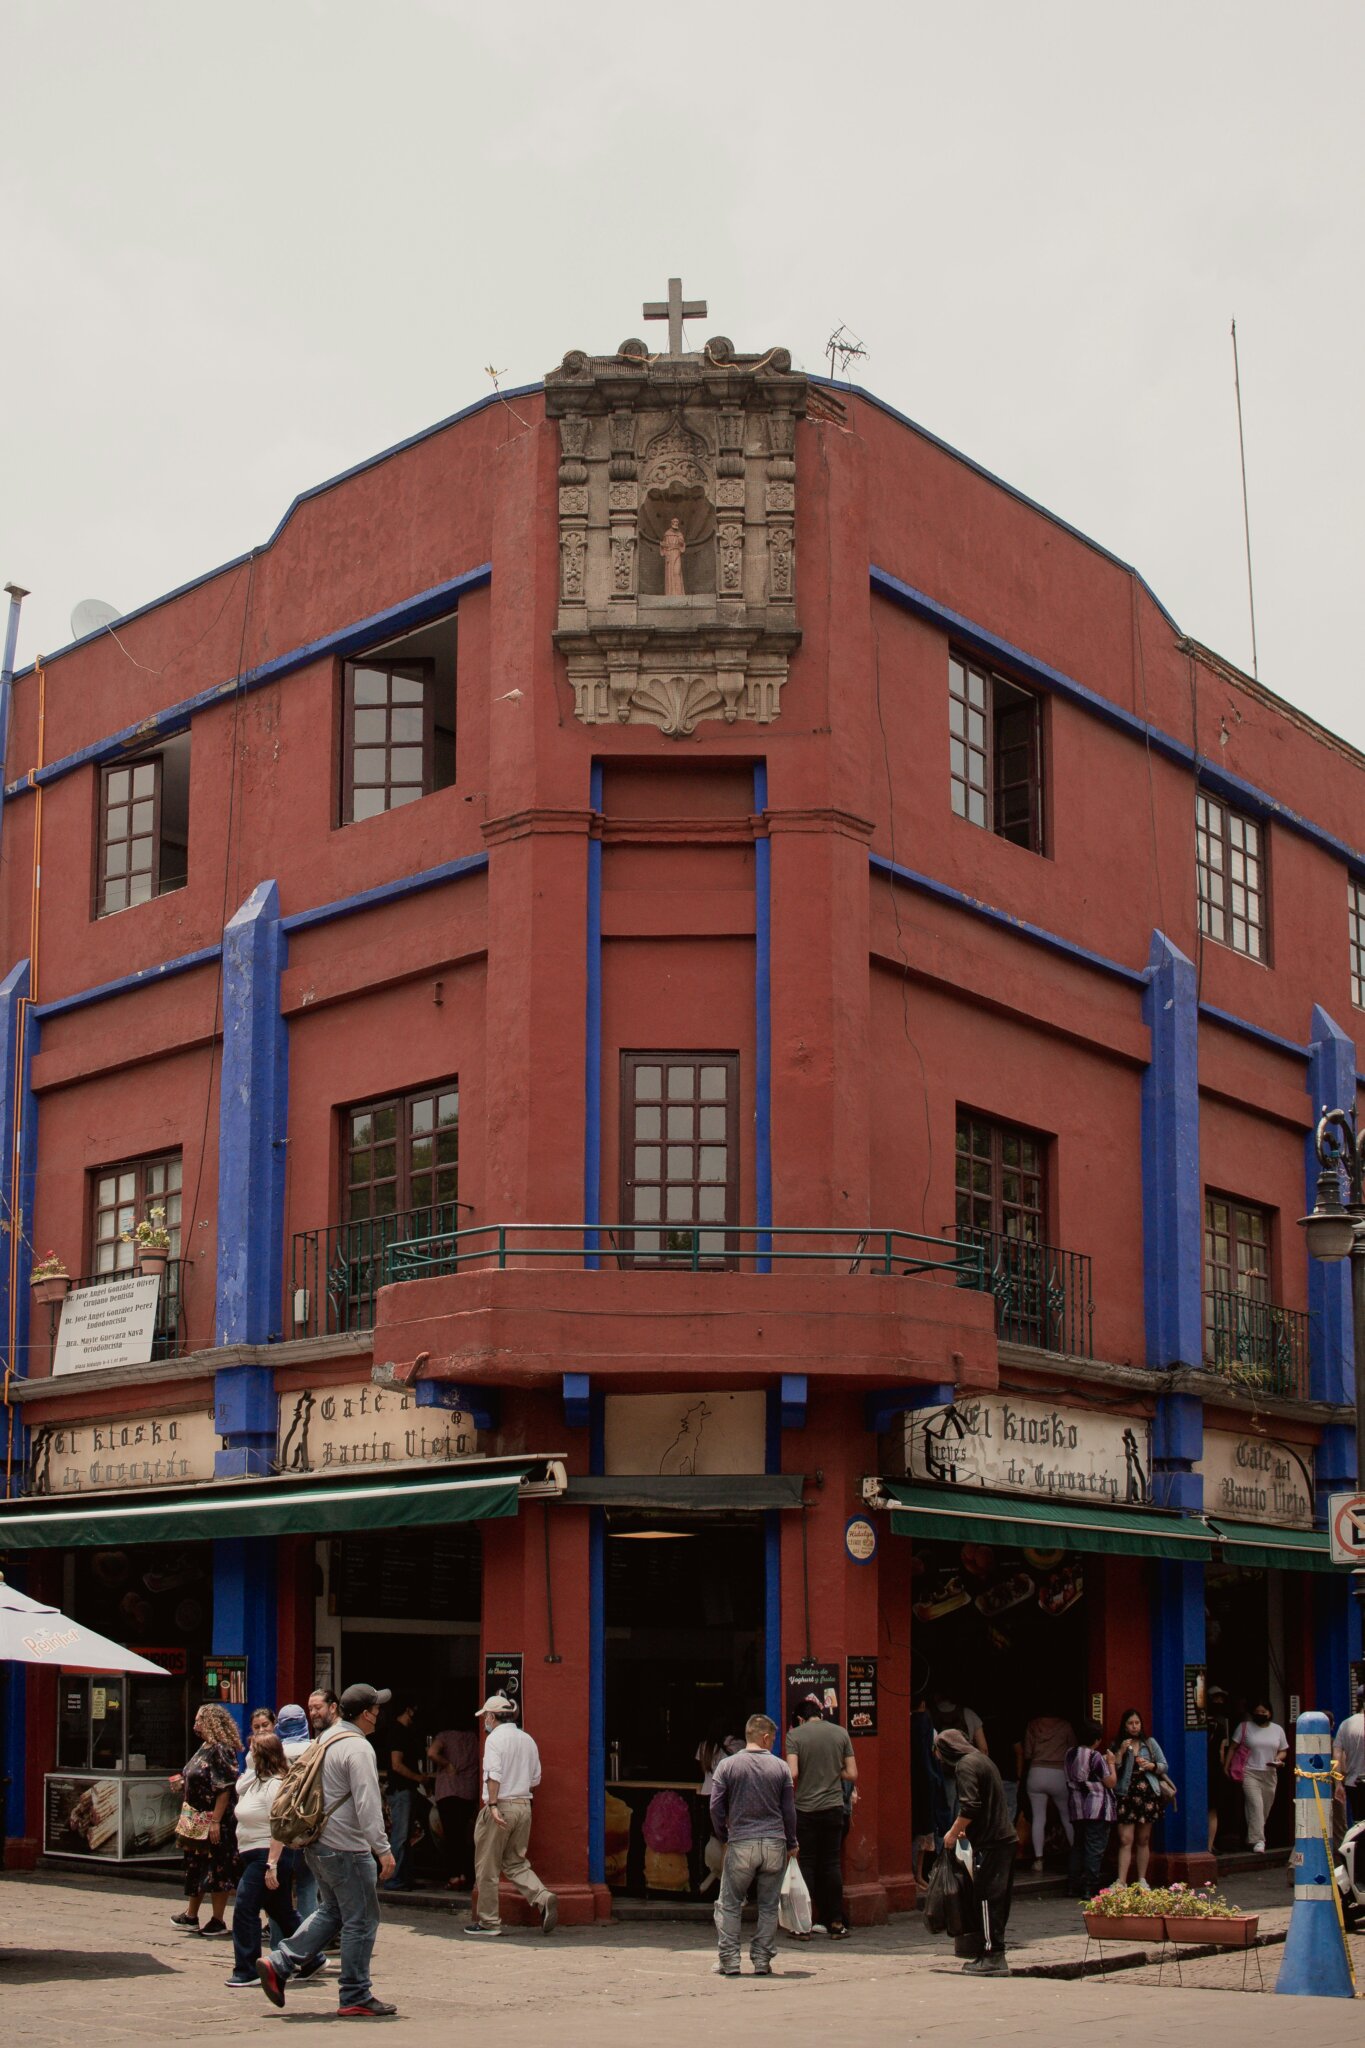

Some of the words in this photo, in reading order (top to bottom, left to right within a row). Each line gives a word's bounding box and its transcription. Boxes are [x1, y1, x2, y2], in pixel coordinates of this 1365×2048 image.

[109, 1292, 134, 1302] Dentista
[321, 1387, 385, 1421] Café
[323, 1432, 392, 1467] Barrio
[405, 1425, 467, 1461] Viejo
[1003, 1458, 1026, 1486] de
[1273, 1458, 1290, 1481] del
[1220, 1477, 1266, 1512] Barrio
[1268, 1482, 1307, 1516] Viejo
[788, 1675, 815, 1685] Yoghurt
[820, 1675, 836, 1684] fruta
[1093, 1695, 1101, 1719] ALIDA
